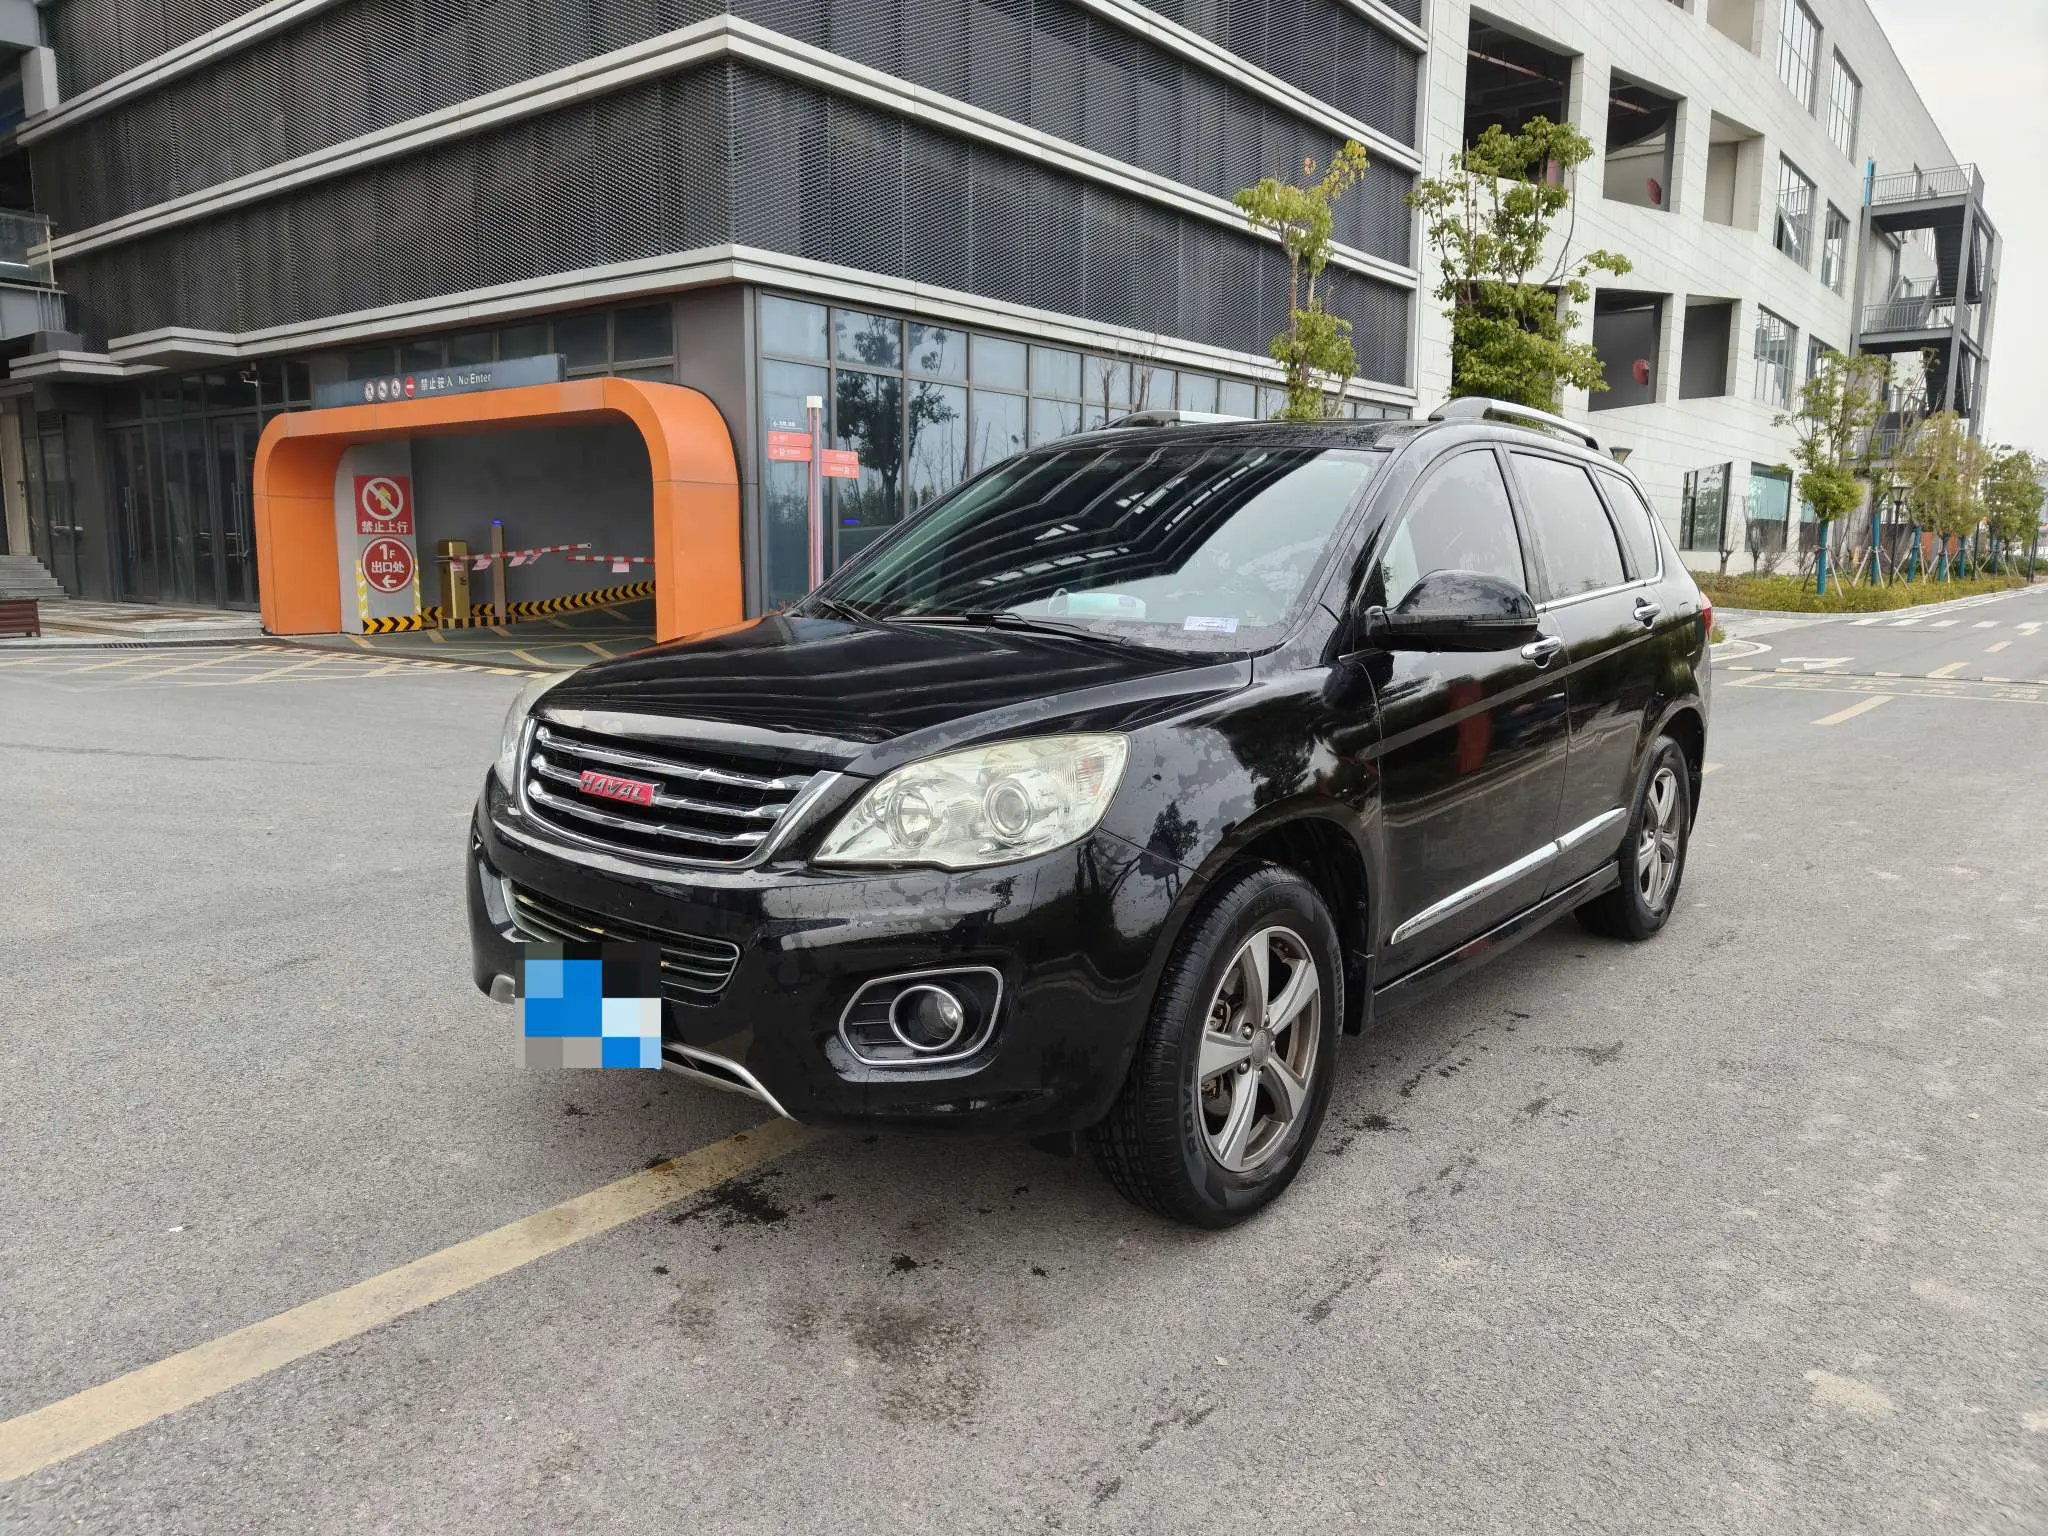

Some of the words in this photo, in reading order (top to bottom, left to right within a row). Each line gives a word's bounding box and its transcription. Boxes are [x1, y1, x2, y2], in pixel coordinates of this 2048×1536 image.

[470, 373, 492, 384] Enter
[361, 520, 409, 534] 禁止上行
[379, 543, 396, 560] 1F
[371, 560, 405, 574] 出口处
[581, 774, 646, 802] HAVAL
